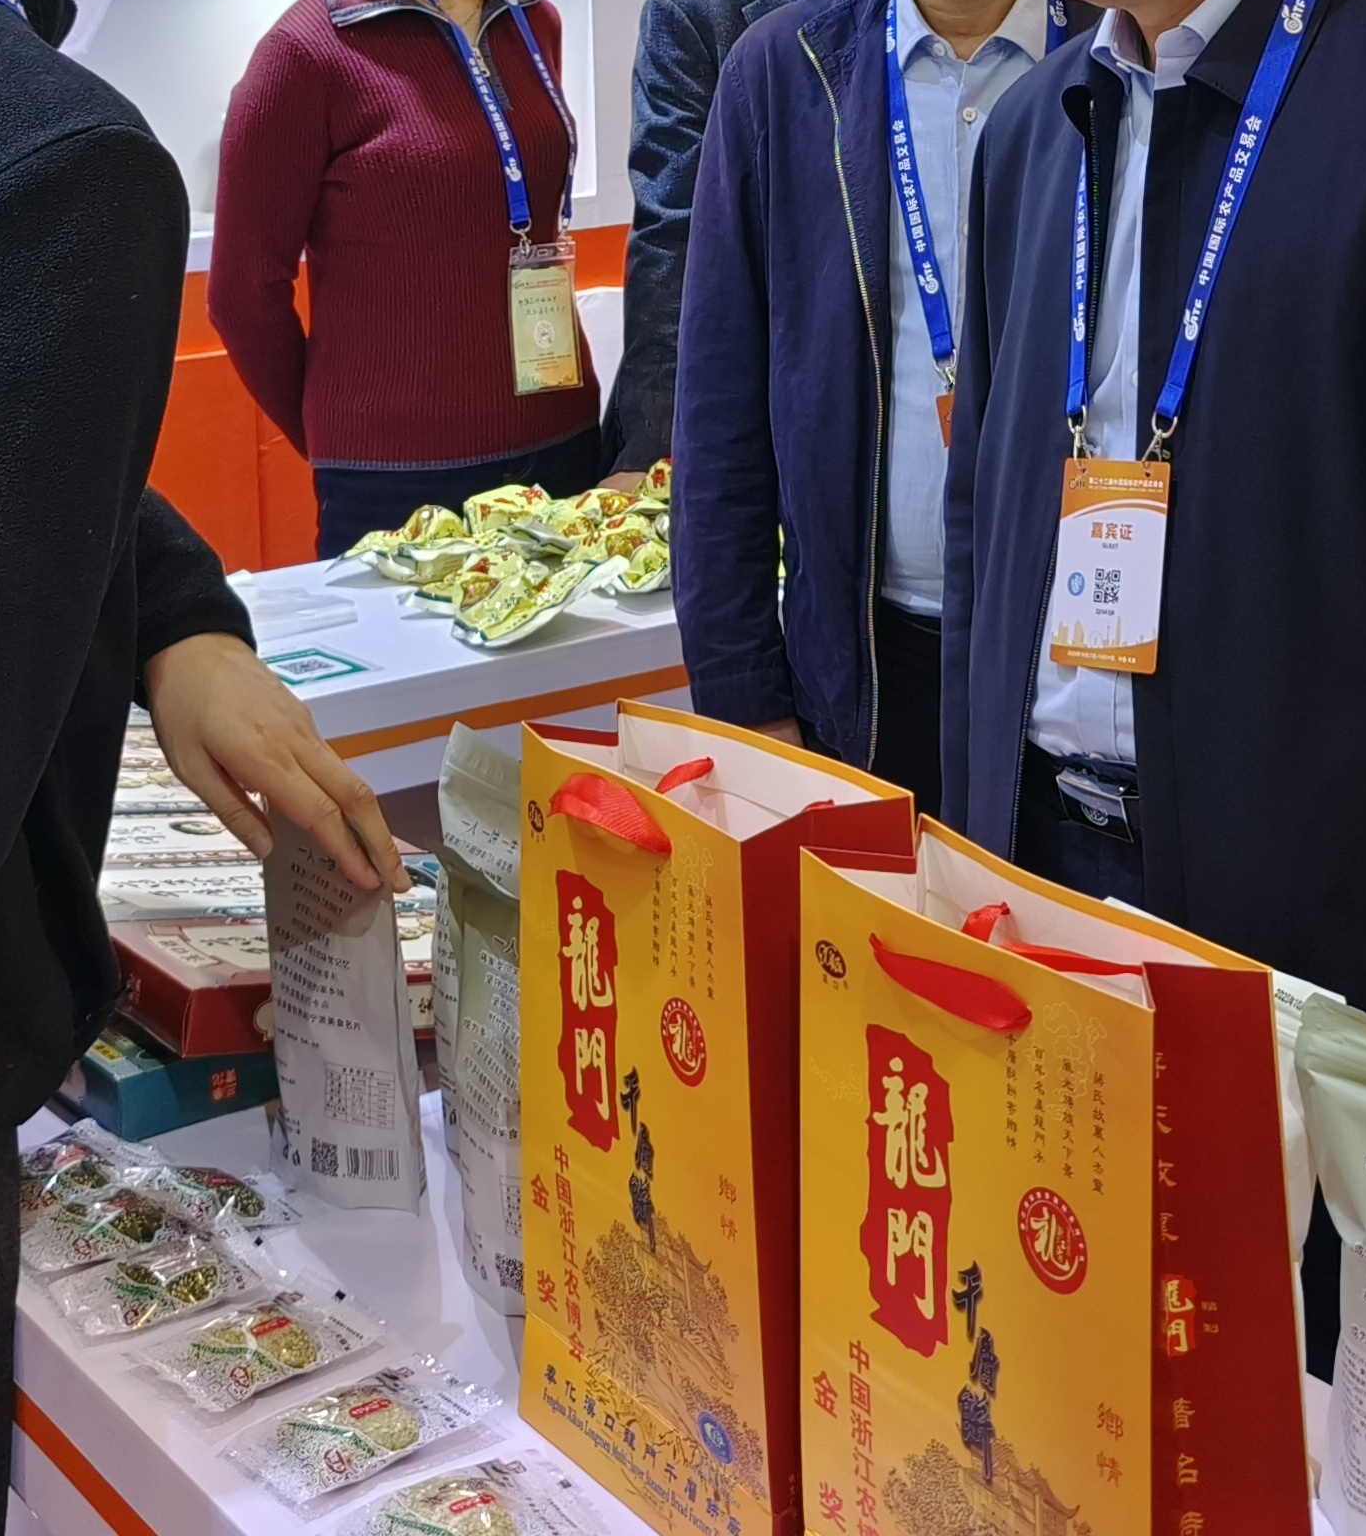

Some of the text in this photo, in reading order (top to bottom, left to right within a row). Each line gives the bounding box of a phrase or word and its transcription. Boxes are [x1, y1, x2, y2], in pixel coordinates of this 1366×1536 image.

[891, 118, 926, 253] 中国国际农产品交易会
[1198, 115, 1264, 287] 中国国际农产品交易会
[1090, 521, 1133, 542] 嘉宾证
[563, 896, 614, 1122] 龍門
[553, 1142, 585, 1364] 中国浙江农博会
[872, 1056, 947, 1321] 龍門
